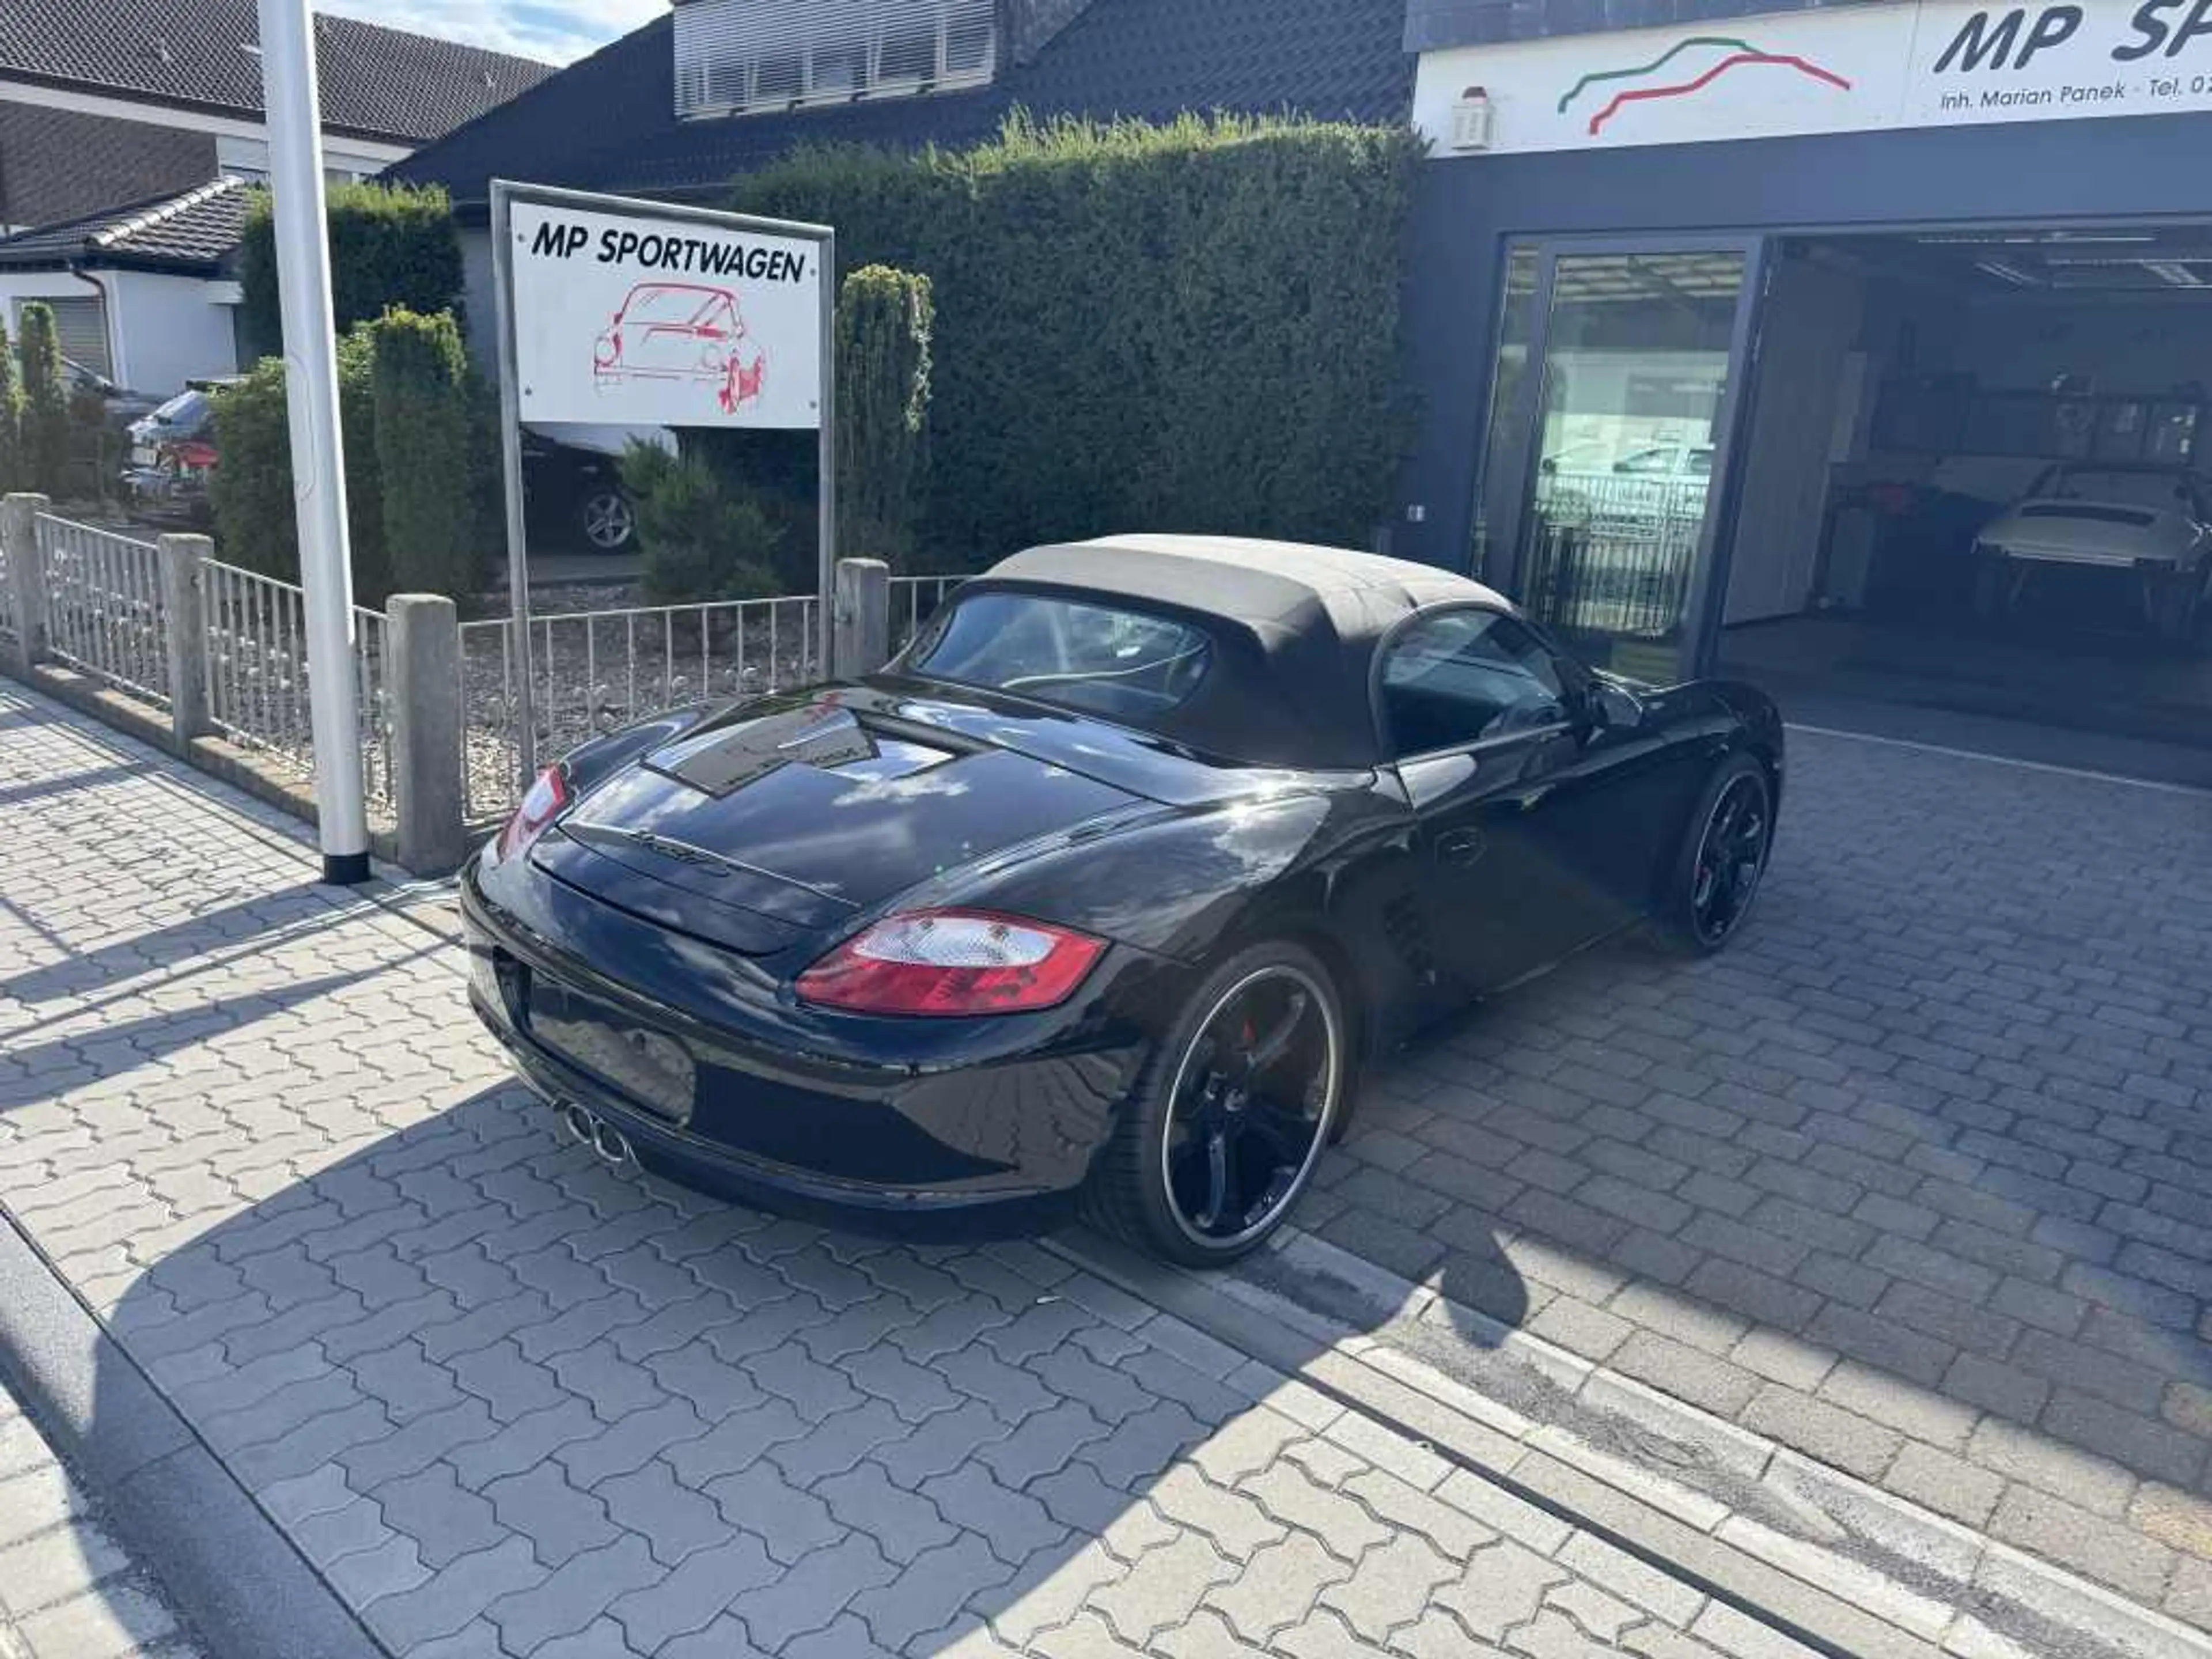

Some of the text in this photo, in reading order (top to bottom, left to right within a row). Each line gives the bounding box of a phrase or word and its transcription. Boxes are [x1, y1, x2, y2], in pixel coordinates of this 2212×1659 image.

[1932, 6, 2083, 73] MP
[1941, 92, 1973, 109] Inh.
[1980, 89, 2051, 108] Marian
[2060, 80, 2125, 103] Panek
[2150, 77, 2183, 97] Tel.
[531, 221, 805, 283] MP SPORTWAGEN
